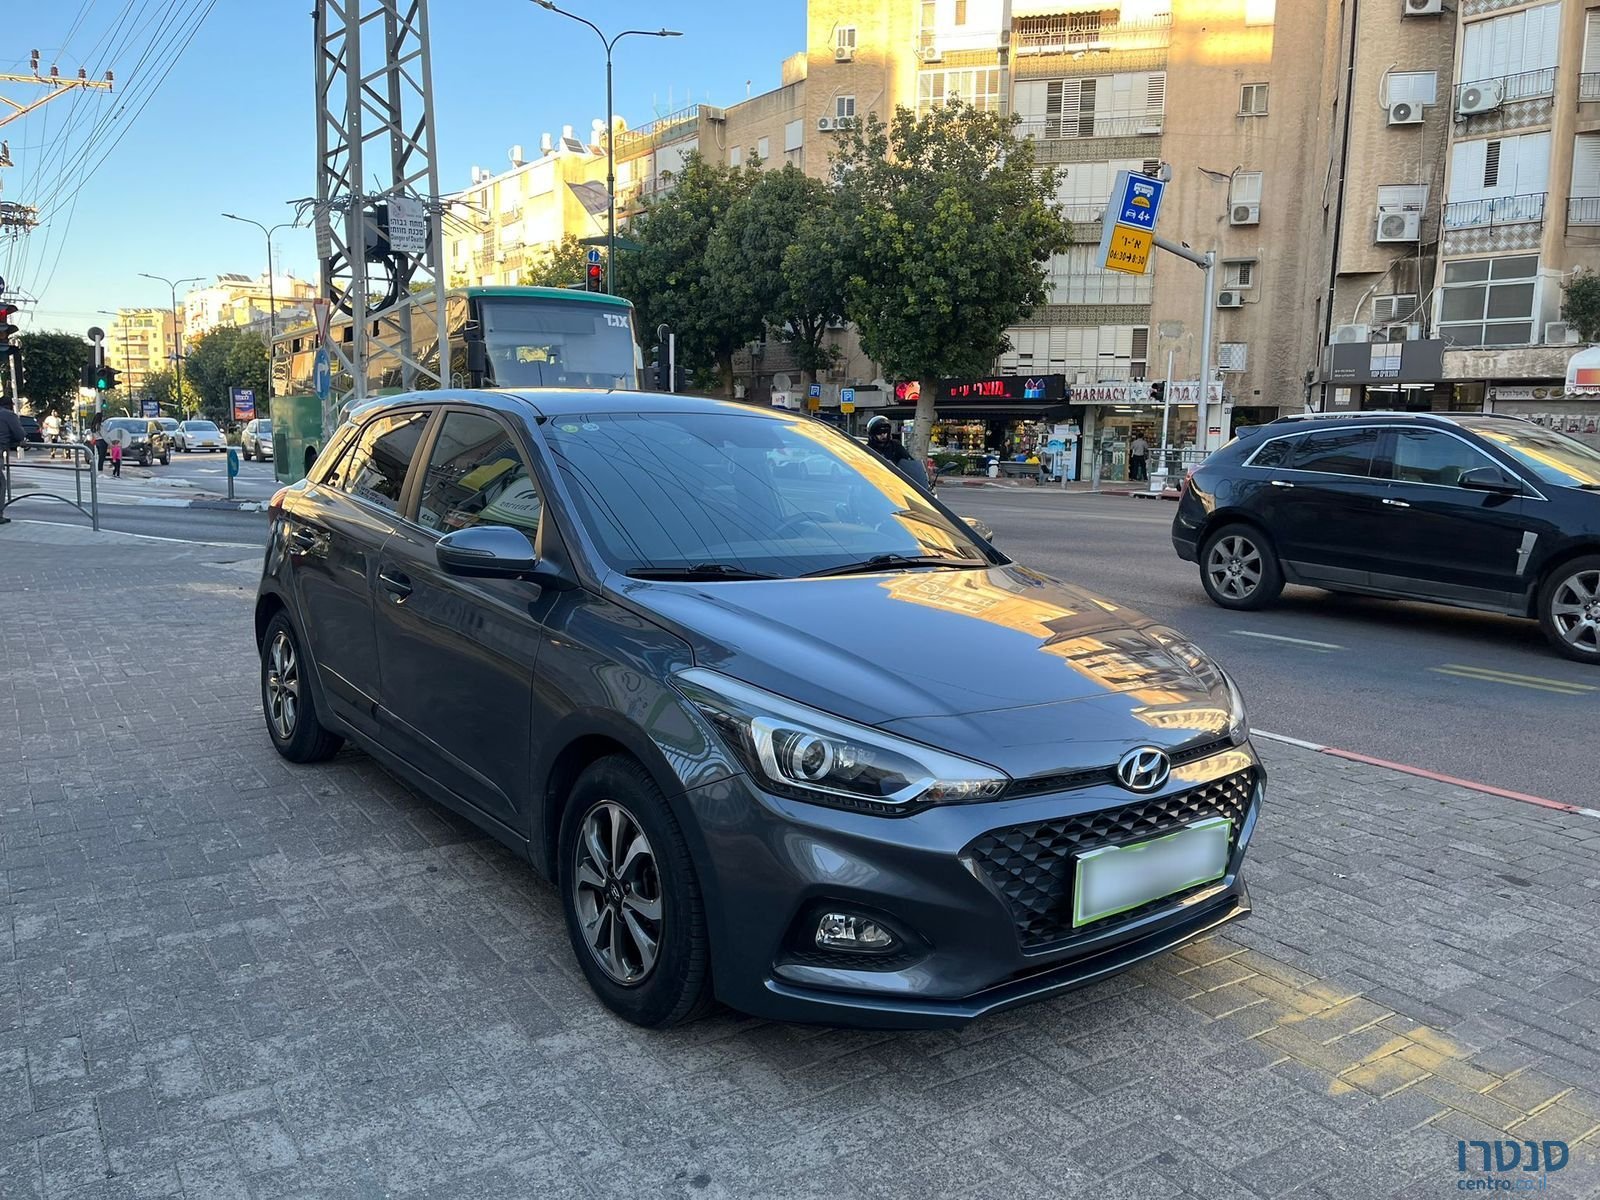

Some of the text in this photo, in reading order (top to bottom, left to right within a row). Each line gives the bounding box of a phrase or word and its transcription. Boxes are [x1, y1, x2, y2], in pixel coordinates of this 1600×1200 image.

[1138, 210, 1150, 221] 4+
[409, 220, 423, 228] מתח
[408, 228, 424, 236] סכנת
[604, 314, 629, 328] אגד
[973, 380, 1004, 396] מוצרי
[1070, 388, 1127, 401] PHARMACY
